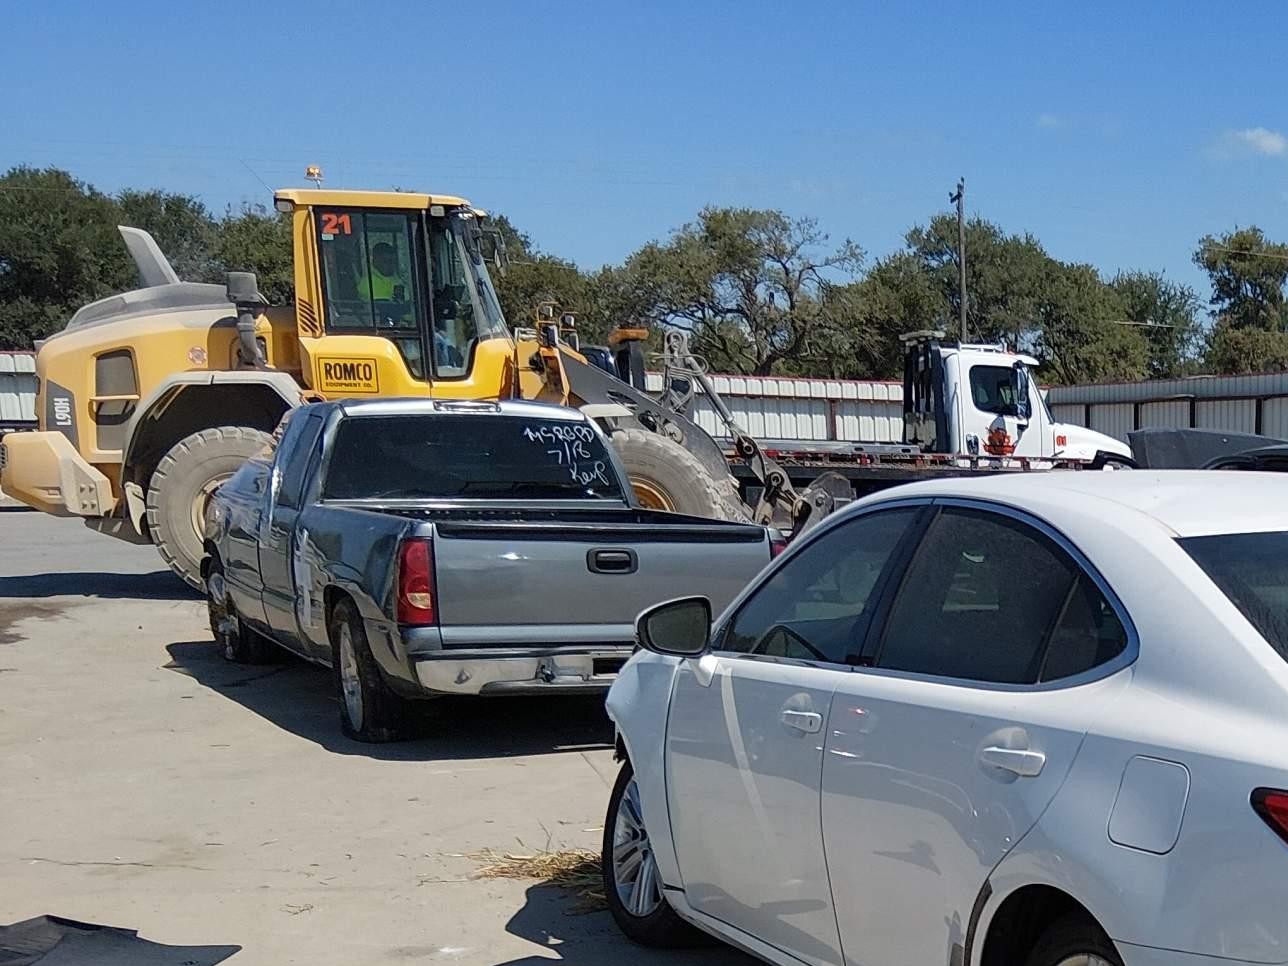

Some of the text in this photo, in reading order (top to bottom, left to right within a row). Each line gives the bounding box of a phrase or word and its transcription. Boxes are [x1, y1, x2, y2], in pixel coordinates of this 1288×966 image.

[321, 213, 352, 235] 21
[324, 362, 372, 381] ROMCO
[53, 397, 73, 426] L90H
